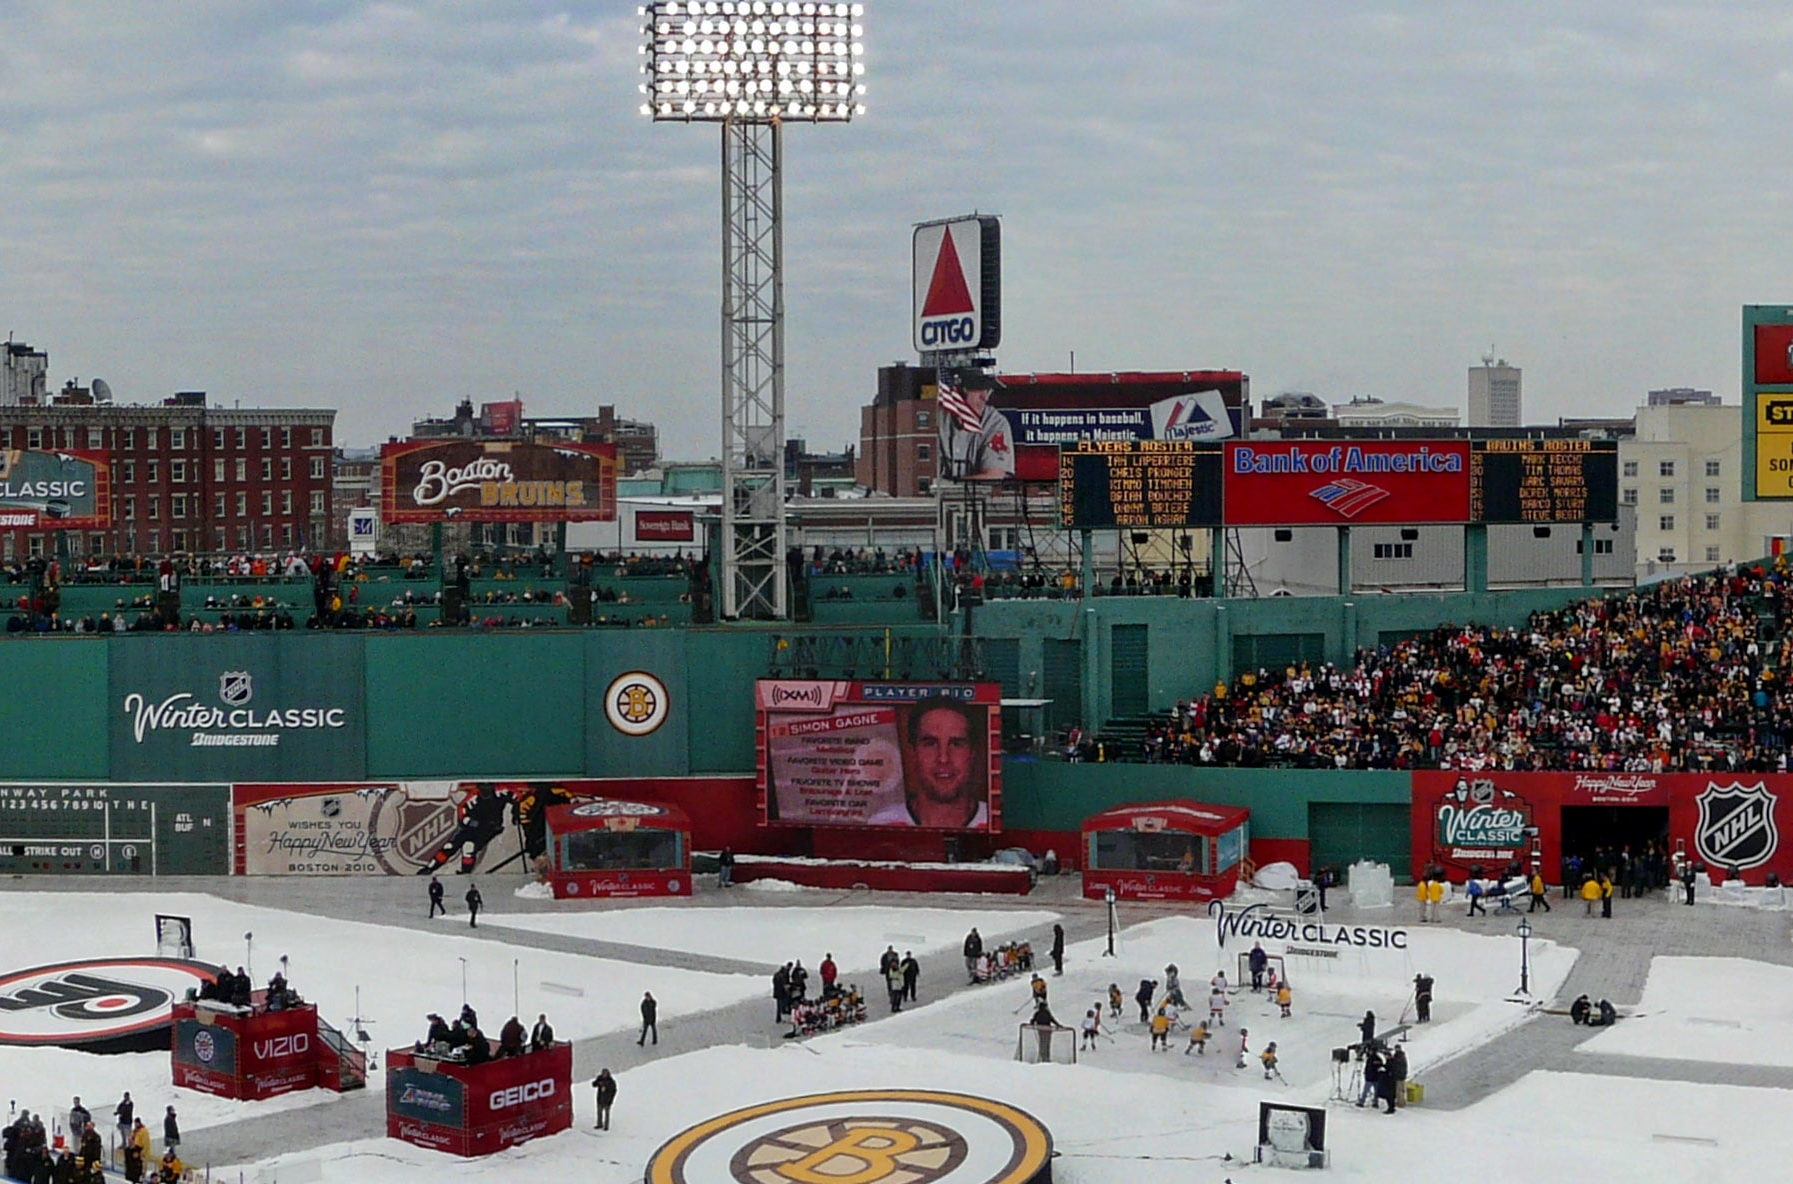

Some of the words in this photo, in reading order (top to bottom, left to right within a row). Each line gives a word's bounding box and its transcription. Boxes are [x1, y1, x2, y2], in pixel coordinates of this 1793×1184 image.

[920, 316, 975, 347] CITGO
[1021, 412, 1032, 425] If
[1032, 412, 1041, 425] it
[1042, 414, 1084, 429] happens
[1086, 412, 1096, 424] in
[1098, 412, 1145, 427] baseball,
[1078, 441, 1133, 452] FLYERS
[1234, 447, 1308, 474] Bank
[1311, 446, 1341, 473] of
[1346, 446, 1463, 474] America
[479, 479, 583, 507] BRUINS
[671, 519, 691, 531] Bank
[864, 688, 929, 697] PLAYER
[124, 692, 227, 744] Winter
[227, 707, 346, 729] CLASSIC
[790, 721, 831, 736] SIMON
[836, 713, 879, 730] GAGNE
[191, 734, 280, 747] BRIDGESTONE
[61, 789, 108, 798] PARK
[176, 813, 193, 823] ATL
[287, 820, 335, 830] WISHES
[339, 820, 362, 830] YOU
[1438, 804, 1524, 846] Winter
[1713, 807, 1762, 844] NHL
[174, 824, 194, 833] BUF
[413, 811, 455, 856] NHL
[1456, 829, 1520, 842] CLASSIC
[24, 846, 58, 857] STRIKE
[62, 846, 82, 857] OUT
[1208, 899, 1301, 949] Winter
[1301, 923, 1409, 950] CLASSIC
[1285, 944, 1339, 959] BRIDGESTONE
[253, 1032, 309, 1059] VIZIO
[489, 1077, 555, 1110] GEICO
